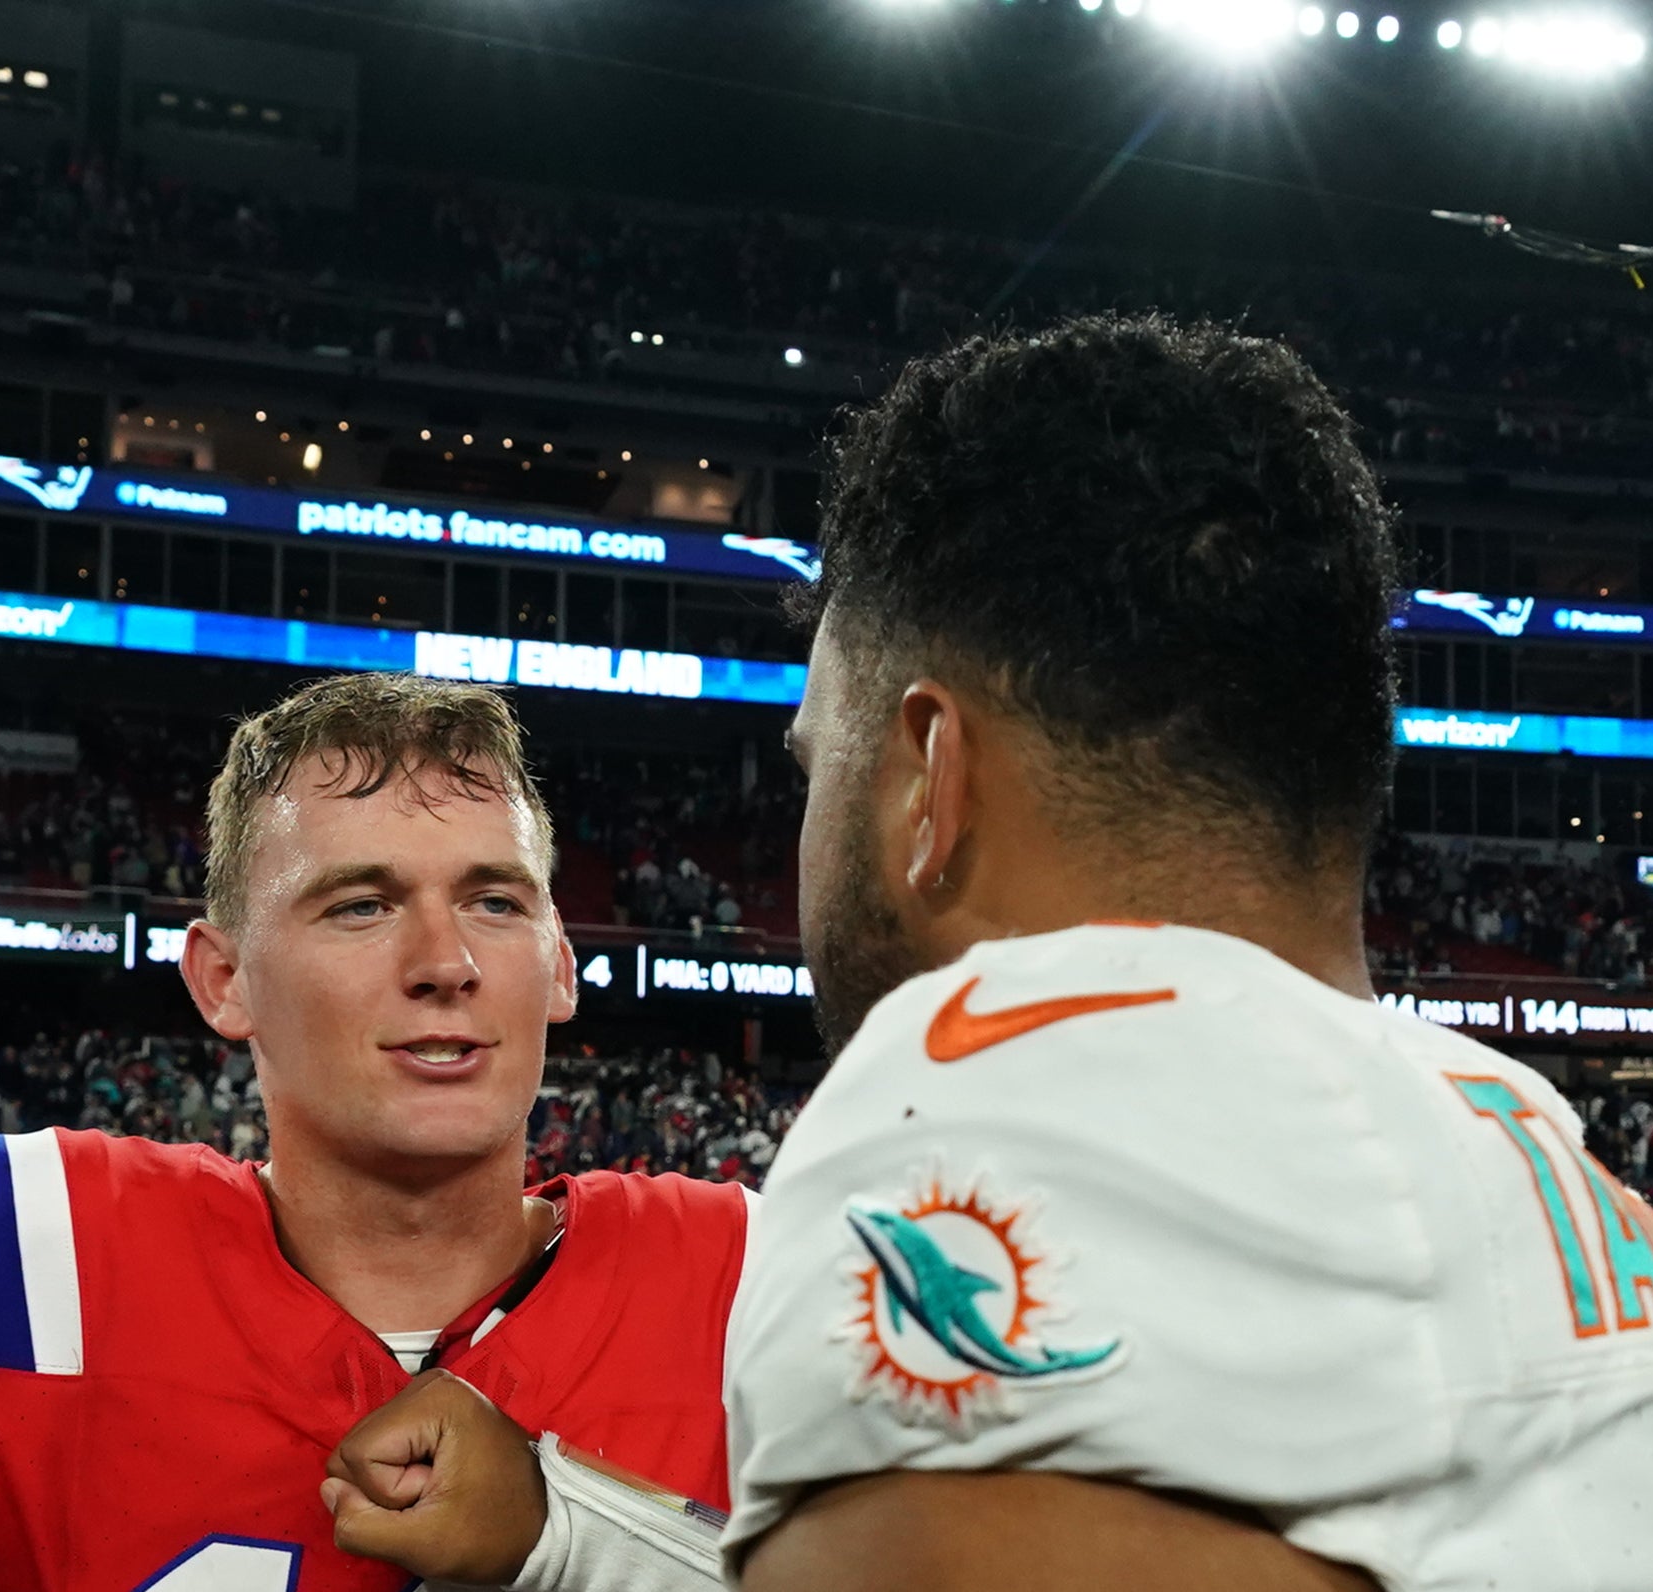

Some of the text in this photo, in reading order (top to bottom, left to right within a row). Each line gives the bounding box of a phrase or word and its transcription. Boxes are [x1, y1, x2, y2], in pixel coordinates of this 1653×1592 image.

[414, 631, 702, 698] NEW ENGLAND
[1402, 715, 1510, 747] verizon
[1521, 998, 1579, 1034] 144
